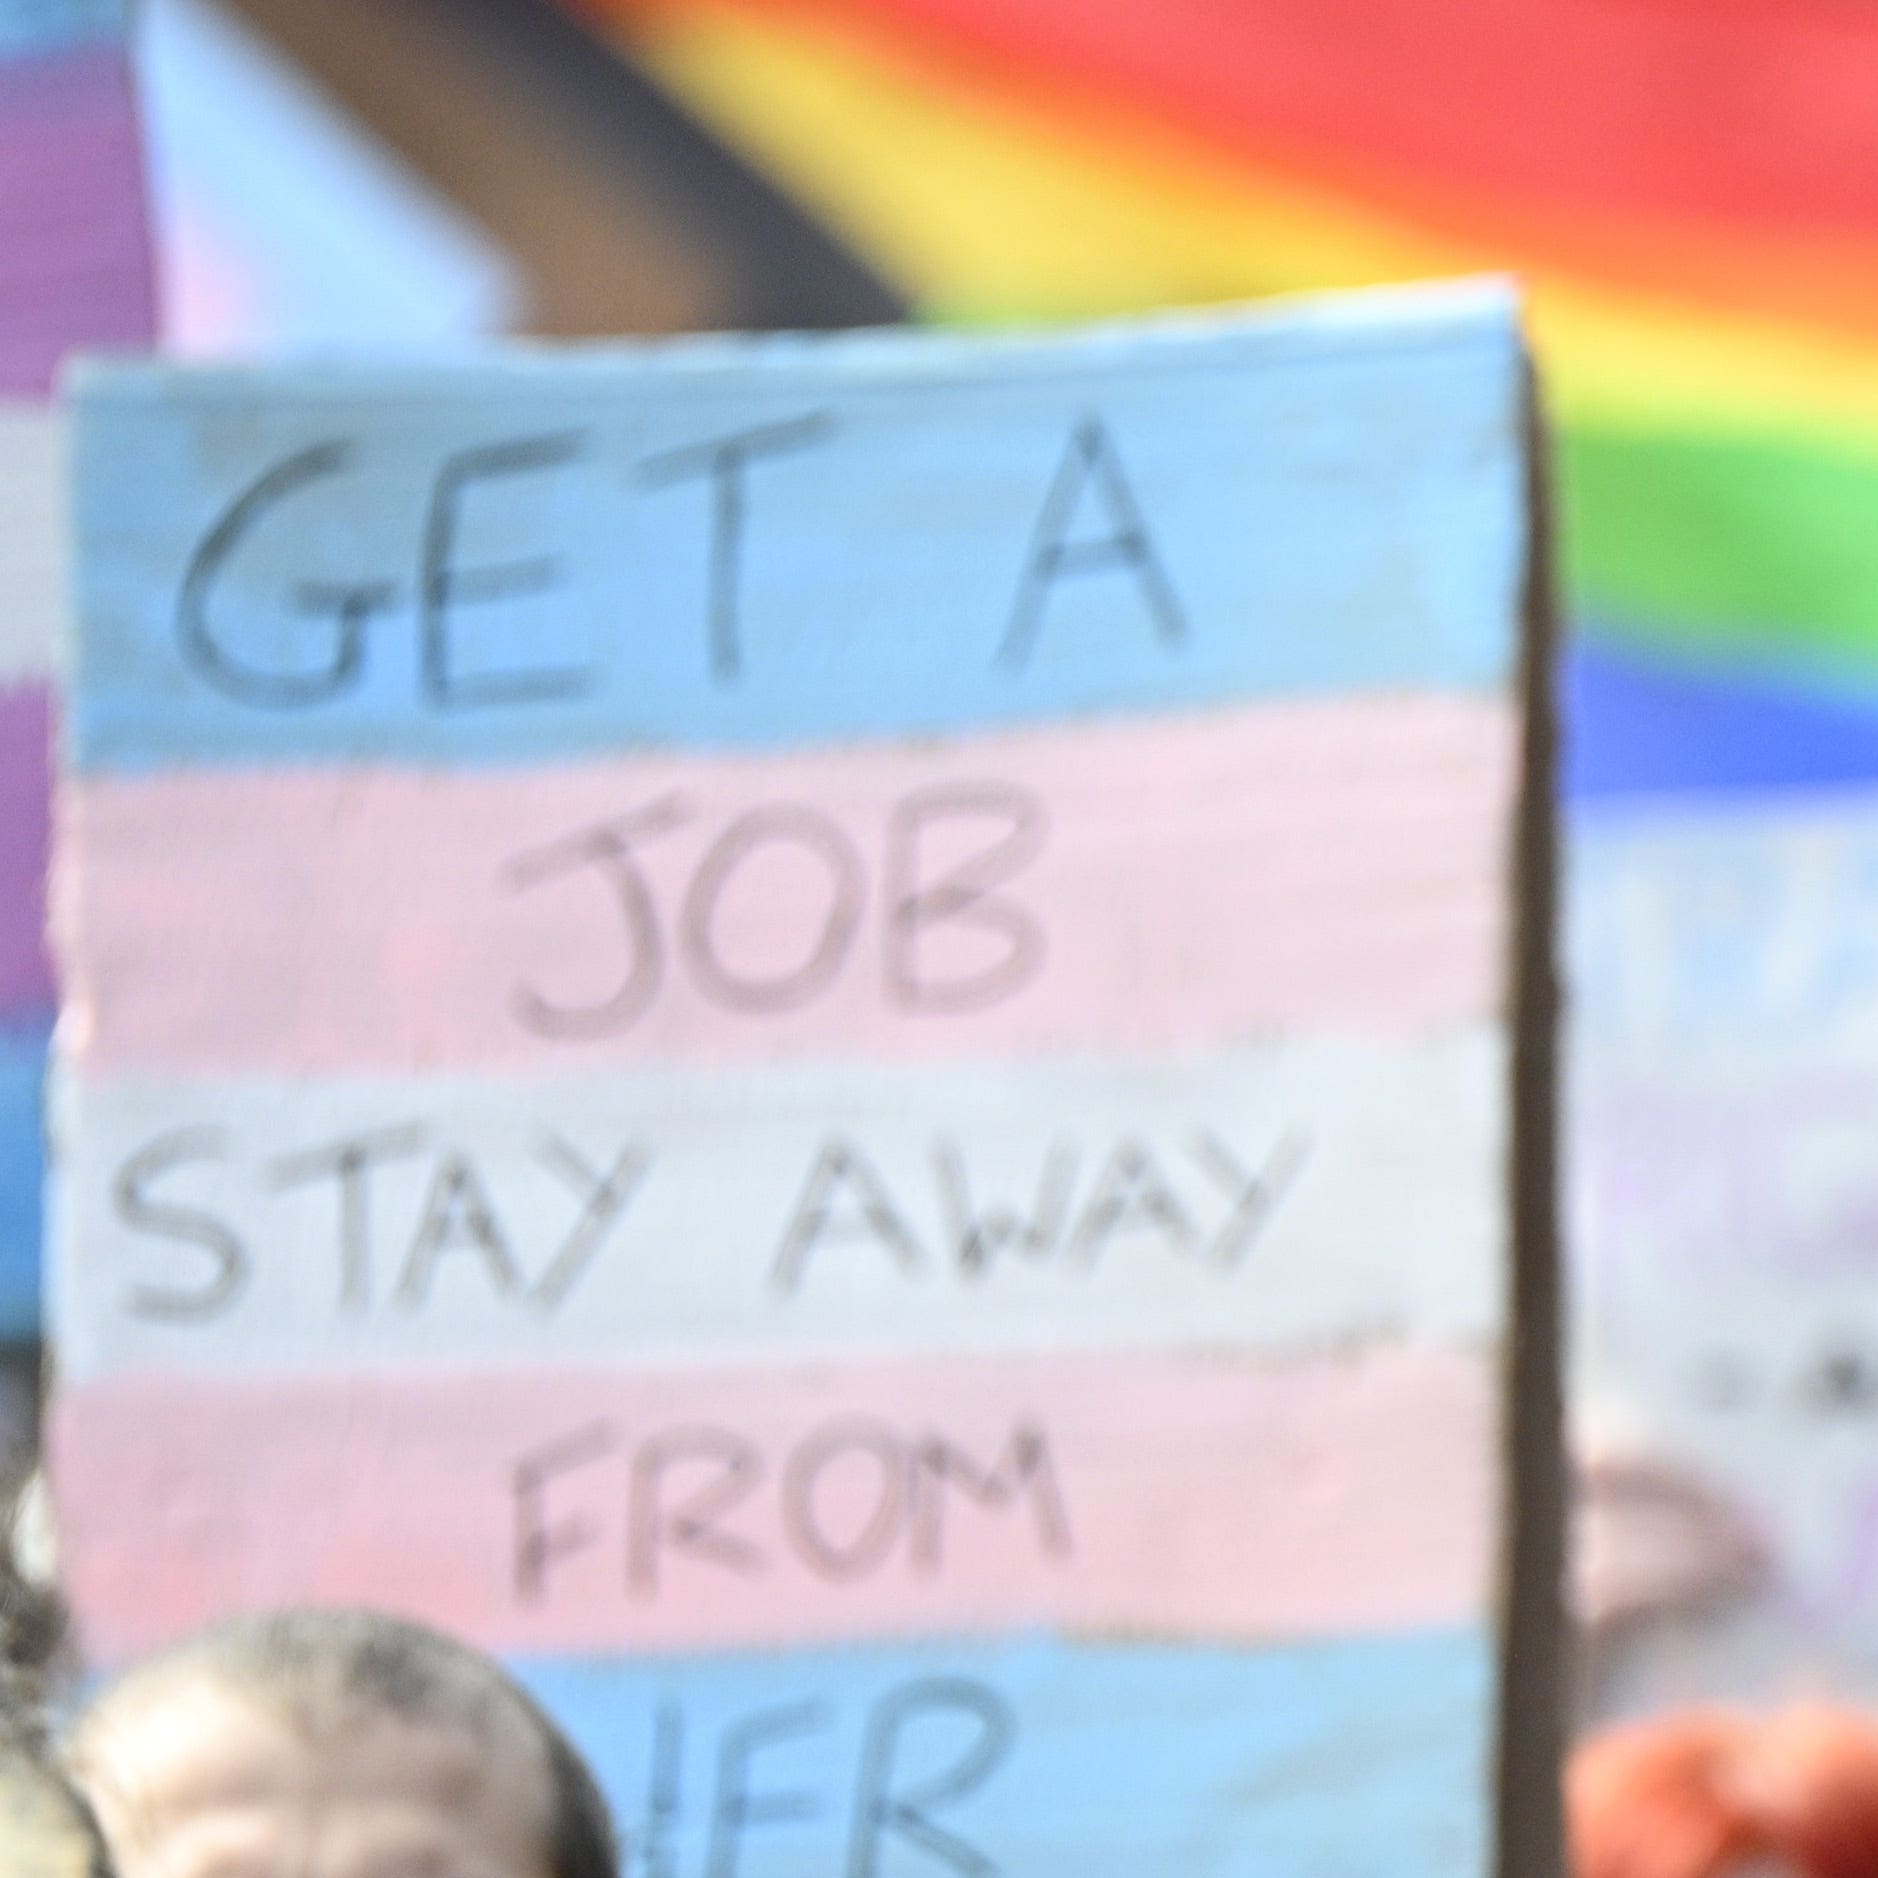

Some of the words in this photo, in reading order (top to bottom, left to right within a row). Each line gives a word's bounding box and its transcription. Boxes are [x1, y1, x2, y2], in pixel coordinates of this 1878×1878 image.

[176, 416, 838, 712] GET
[996, 408, 1190, 674] A
[502, 780, 1052, 1047] JOB
[112, 1122, 656, 1324] STAY
[770, 1122, 1317, 1300] AWAY
[512, 1410, 1075, 1608] FROM
